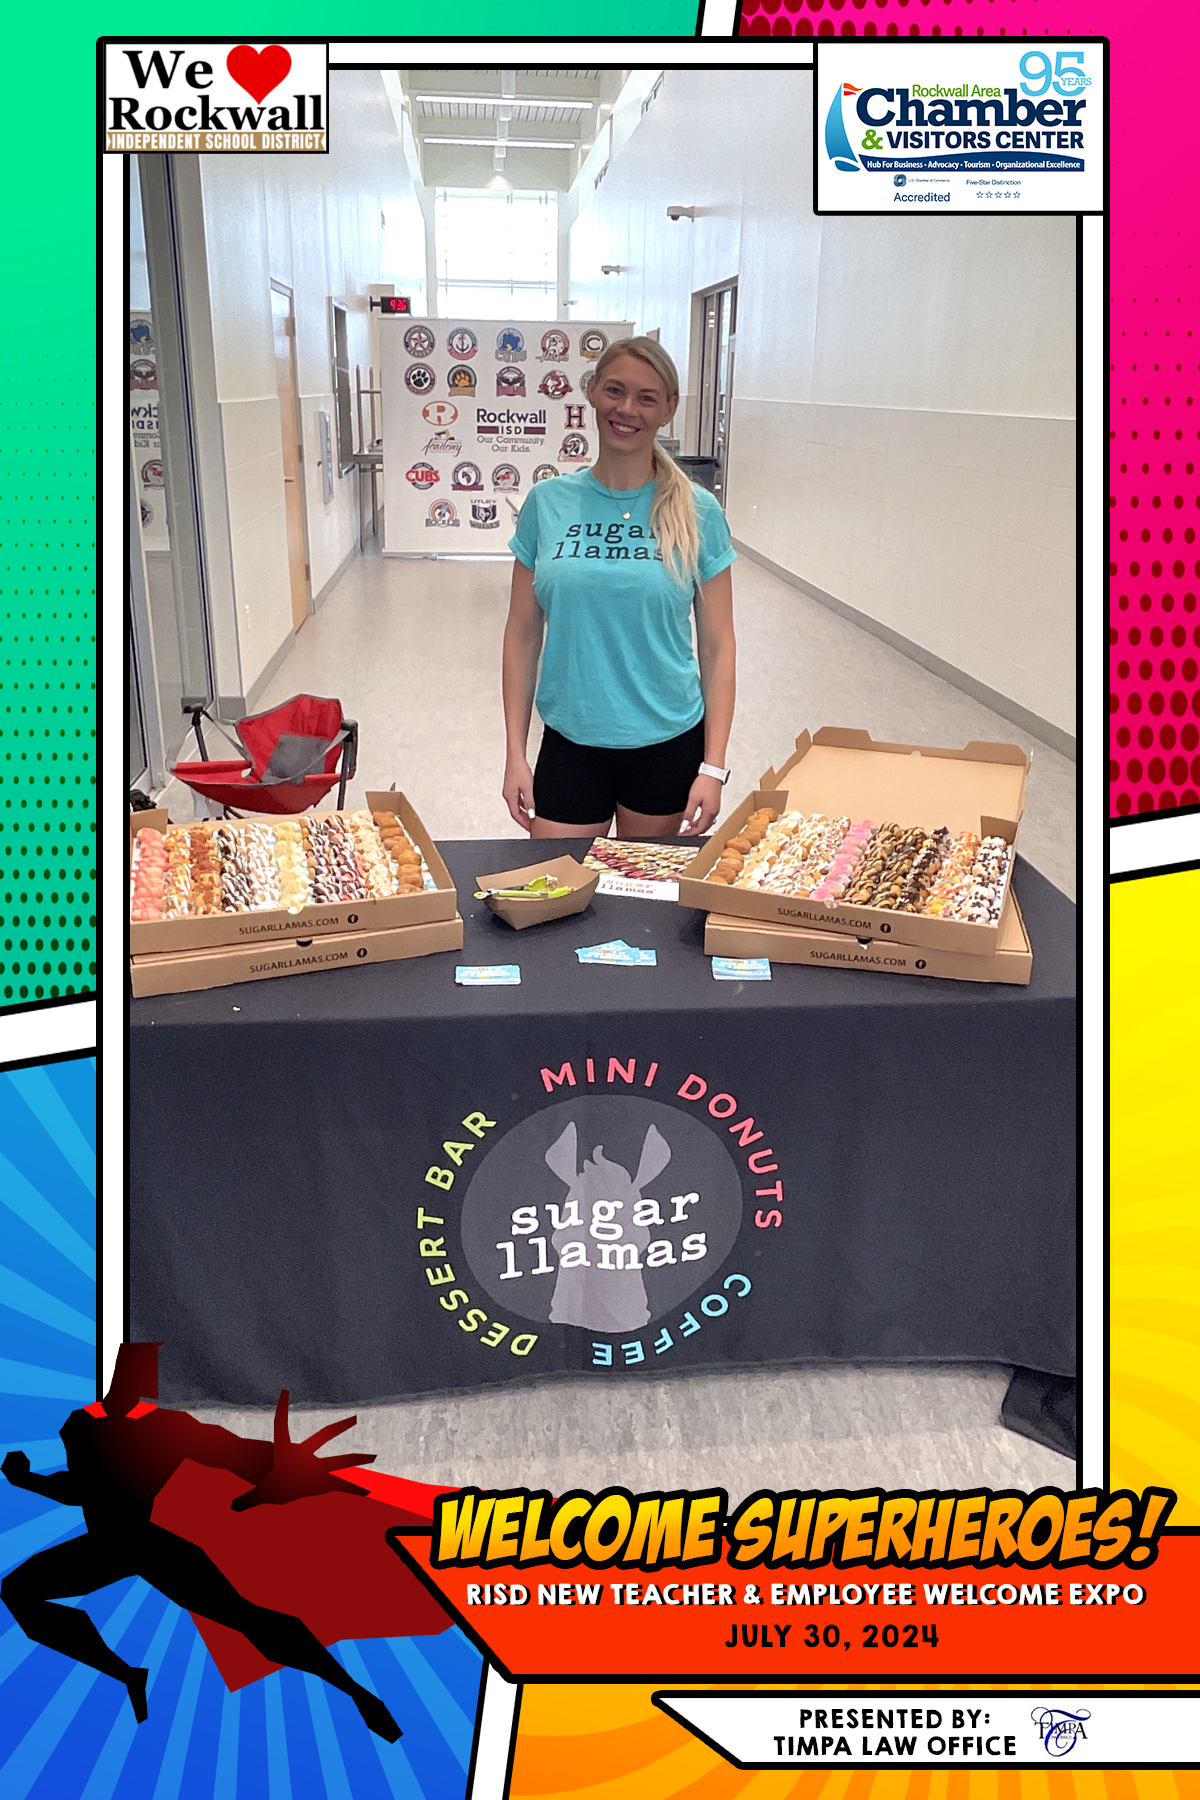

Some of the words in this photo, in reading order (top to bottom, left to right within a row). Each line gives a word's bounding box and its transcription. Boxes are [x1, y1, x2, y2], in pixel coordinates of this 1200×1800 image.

[476, 408, 547, 424] Rockwall
[476, 435, 494, 444] Our
[500, 426, 523, 435] ISD
[491, 444, 508, 453] Our
[405, 469, 441, 483] CUBS
[239, 916, 340, 936] SUGARLLAMAS.COM
[777, 907, 872, 931] SUGARLLAMAS.COM
[249, 950, 349, 974] SUGARLLAMAS.COM
[810, 950, 907, 968] SUGARLLAMAS.COM
[425, 1111, 497, 1191] BAR
[540, 1057, 659, 1093] MINI
[677, 1073, 783, 1229] DONUTS
[510, 1192, 700, 1241] sugar
[496, 1232, 708, 1280] llamas
[416, 1207, 538, 1357] DESSERT
[592, 1273, 752, 1366] COFFEE
